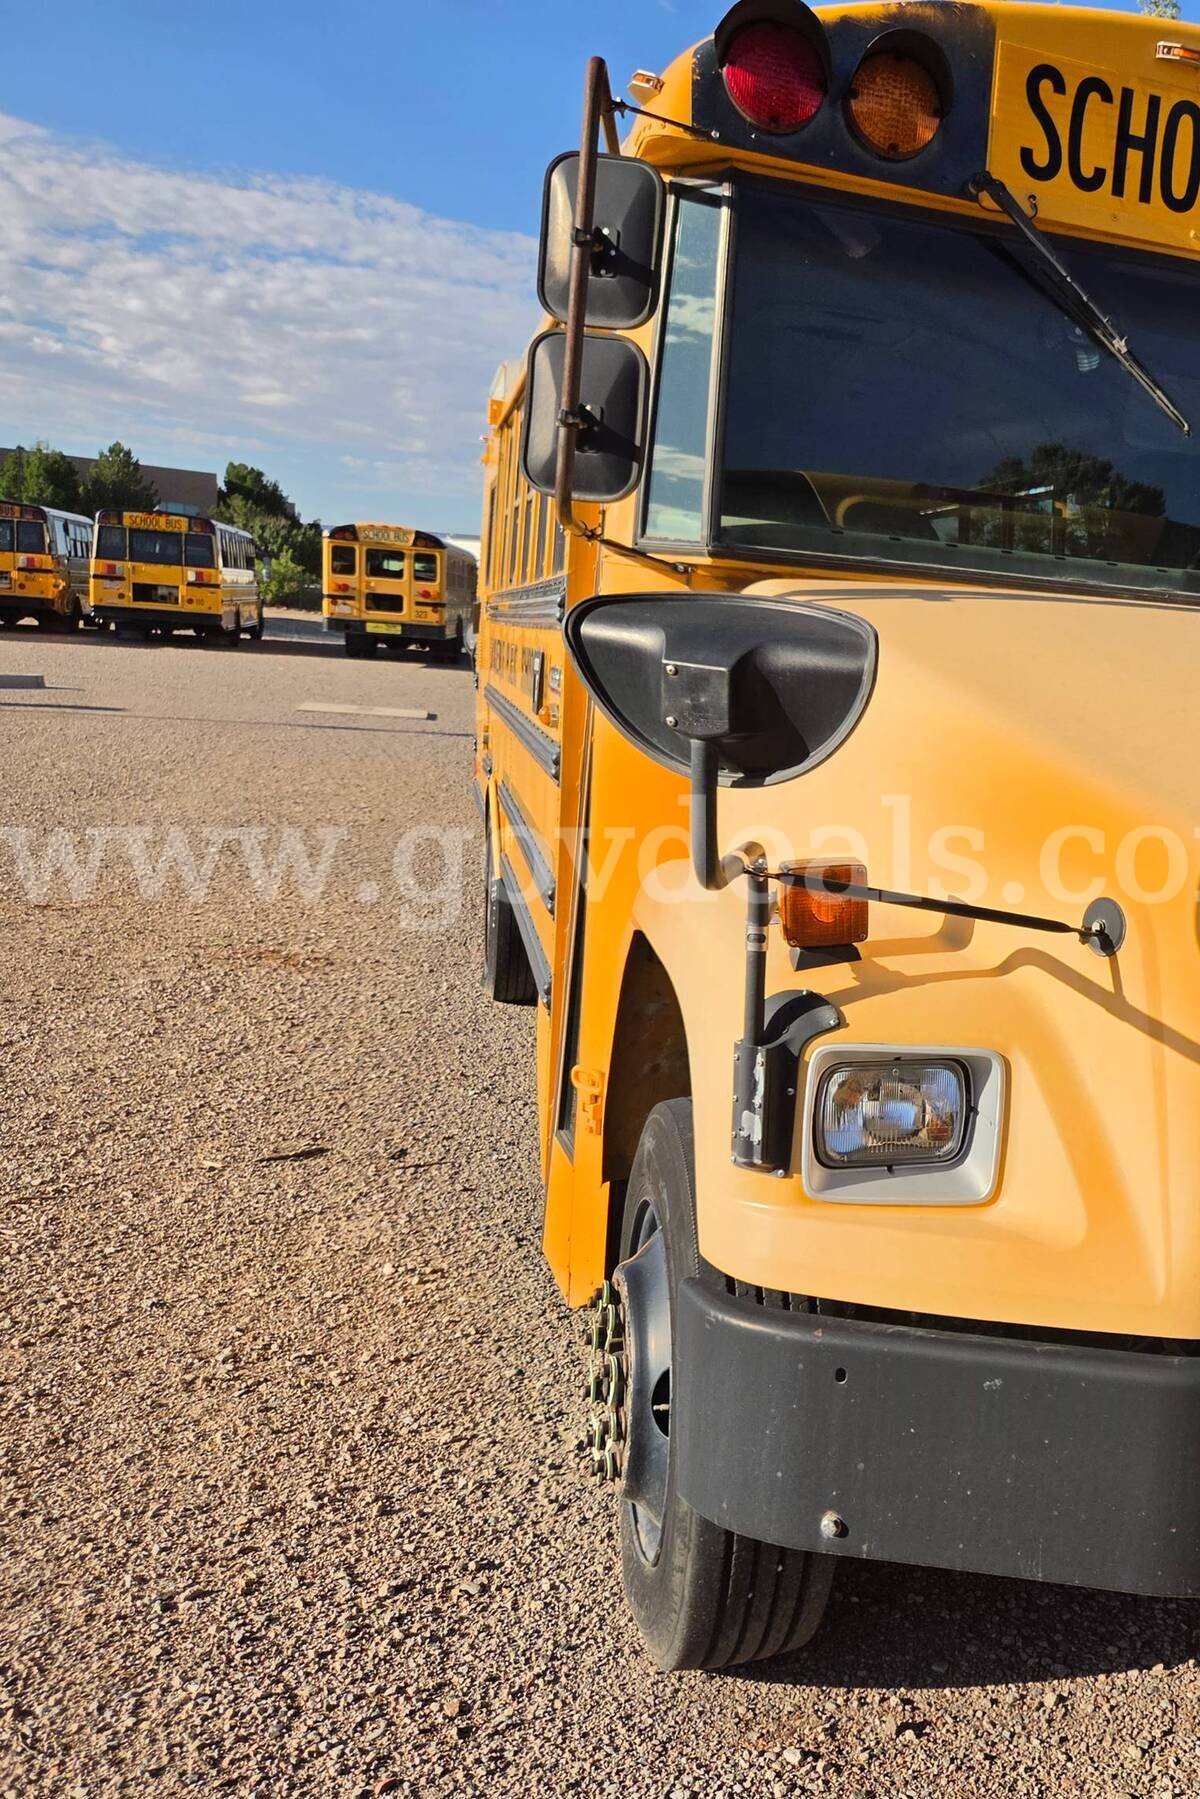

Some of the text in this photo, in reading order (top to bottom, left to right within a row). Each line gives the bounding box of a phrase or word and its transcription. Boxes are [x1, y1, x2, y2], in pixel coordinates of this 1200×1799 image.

[128, 514, 183, 529] SCHOOL BUS
[362, 528, 410, 543] SCHOOL BUS
